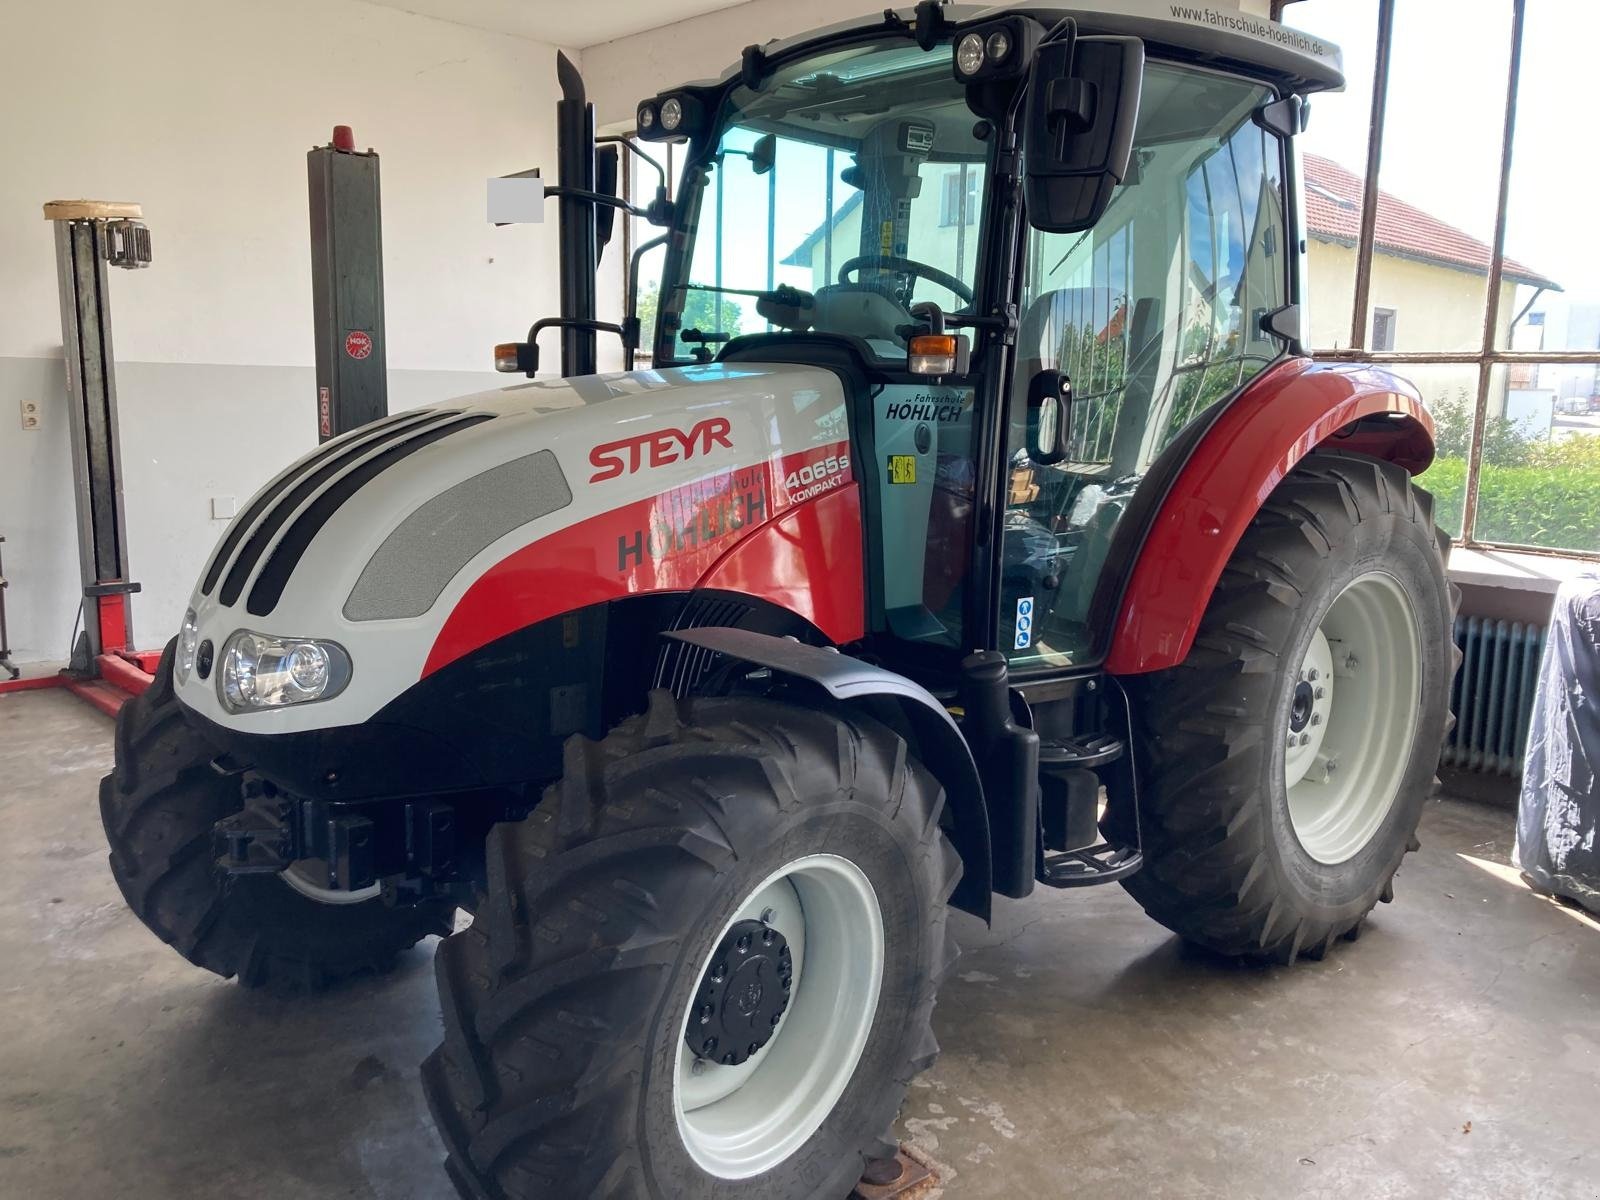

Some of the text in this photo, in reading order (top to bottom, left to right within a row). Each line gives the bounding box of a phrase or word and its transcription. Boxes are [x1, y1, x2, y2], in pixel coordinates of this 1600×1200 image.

[1170, 6, 1323, 56] www.fahrschule-hoehlich.de
[350, 338, 367, 346] NGK
[886, 398, 962, 422] HÖHLICH
[589, 417, 734, 484] STEYR
[788, 474, 842, 505] KOMPAKT
